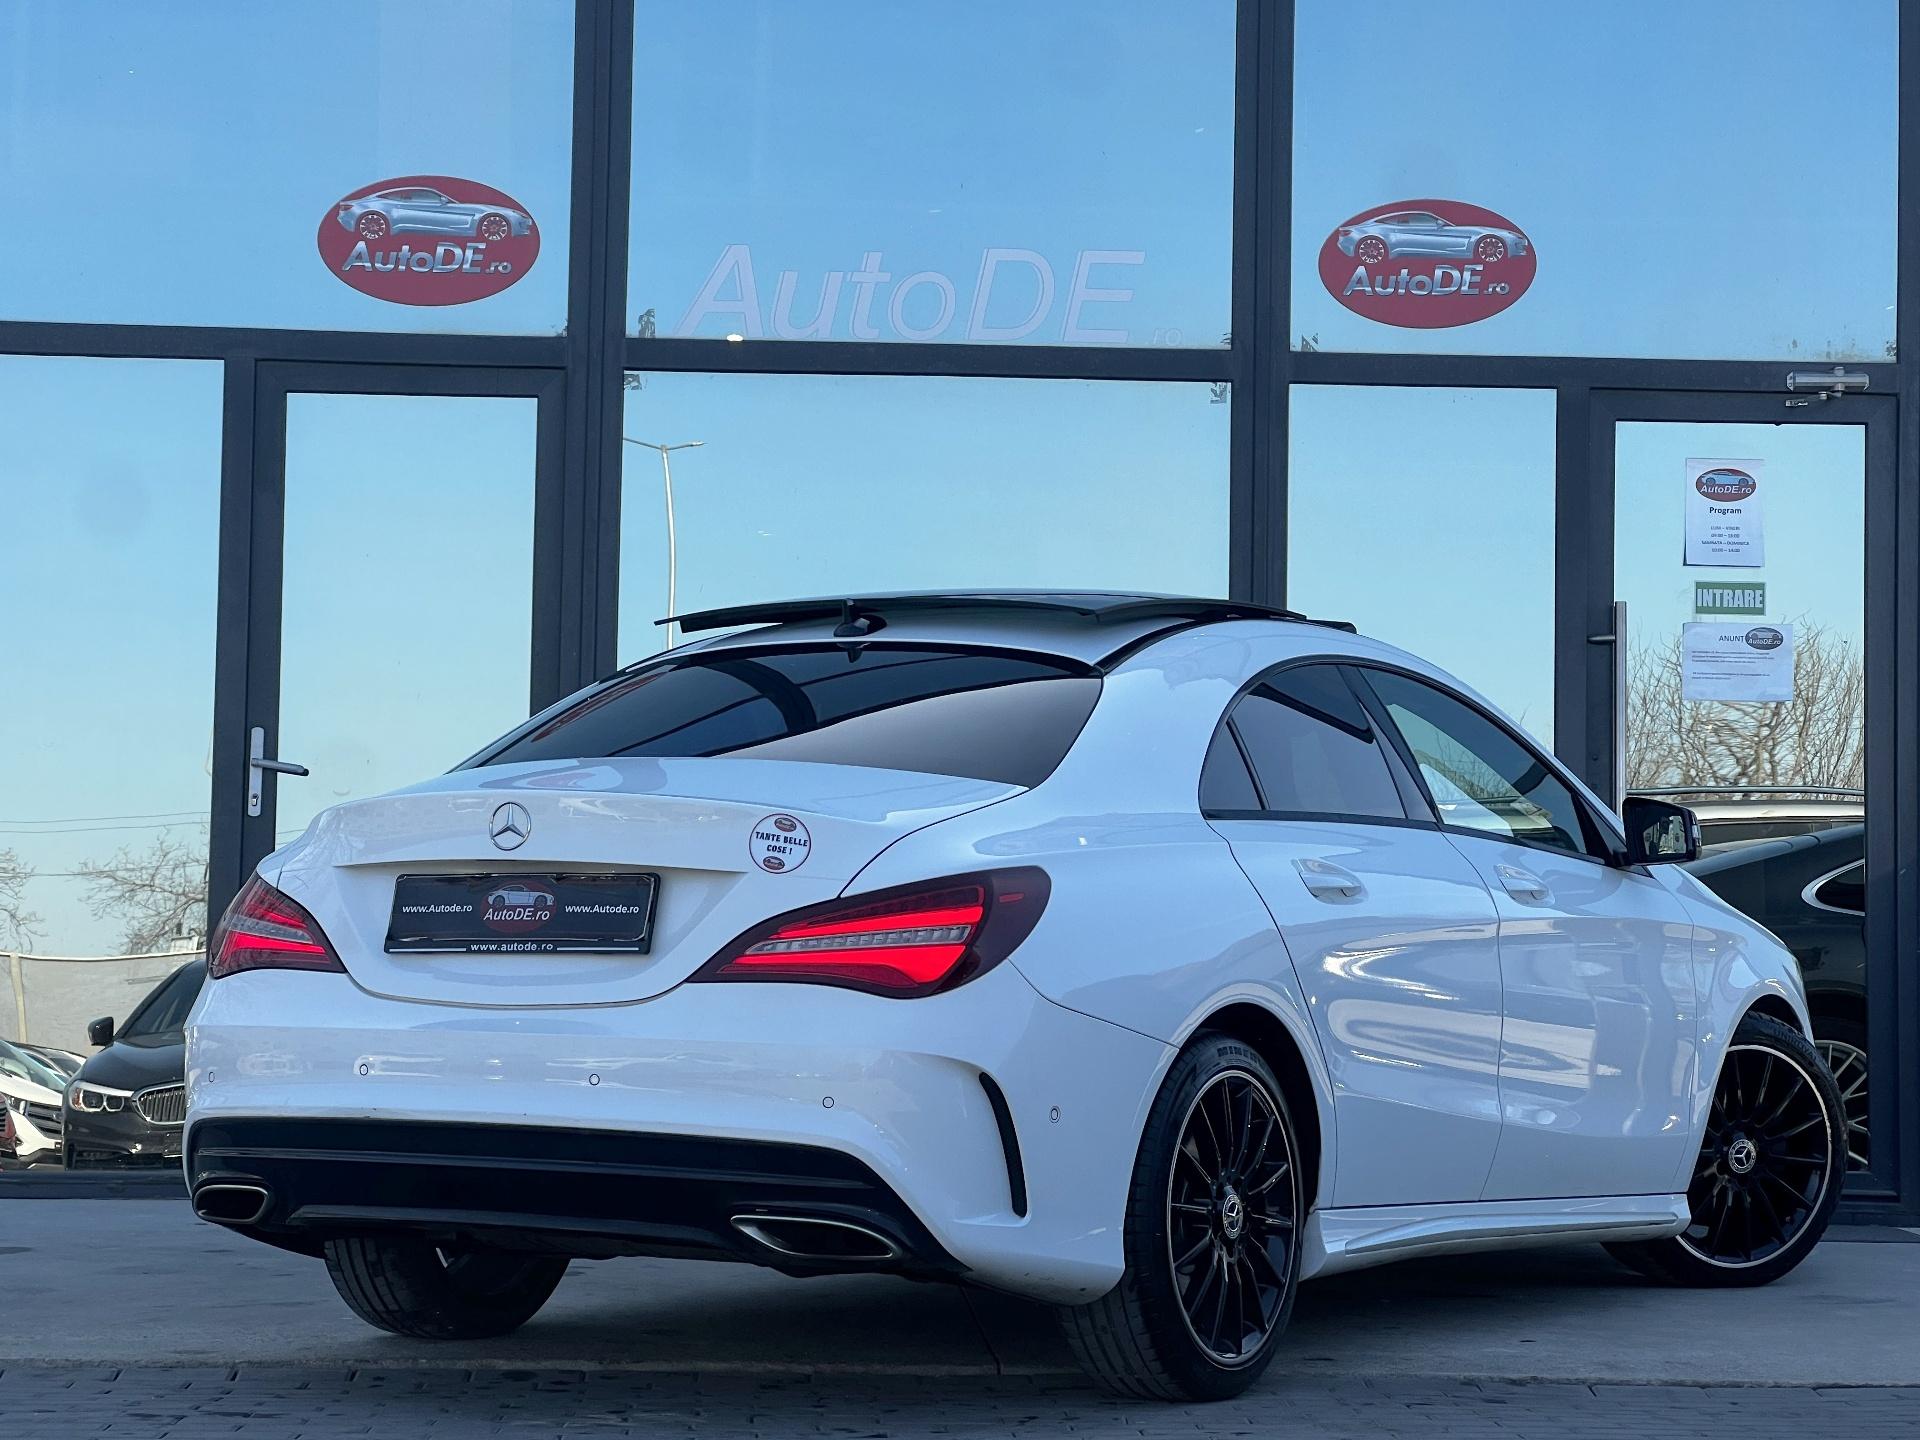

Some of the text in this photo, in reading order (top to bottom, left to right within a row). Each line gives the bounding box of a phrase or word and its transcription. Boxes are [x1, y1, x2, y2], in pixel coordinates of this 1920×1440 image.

[1700, 485, 1752, 494] AutoDE.ro
[1709, 507, 1742, 515] Program
[1696, 588, 1764, 608] INTRARE
[755, 831, 808, 847] TANTE BELLE
[402, 903, 473, 914] www.Autode.ro
[565, 904, 640, 915] www.Autode.ro
[483, 907, 550, 922] AutoDE.ro
[470, 942, 554, 952] www.autode.ro
